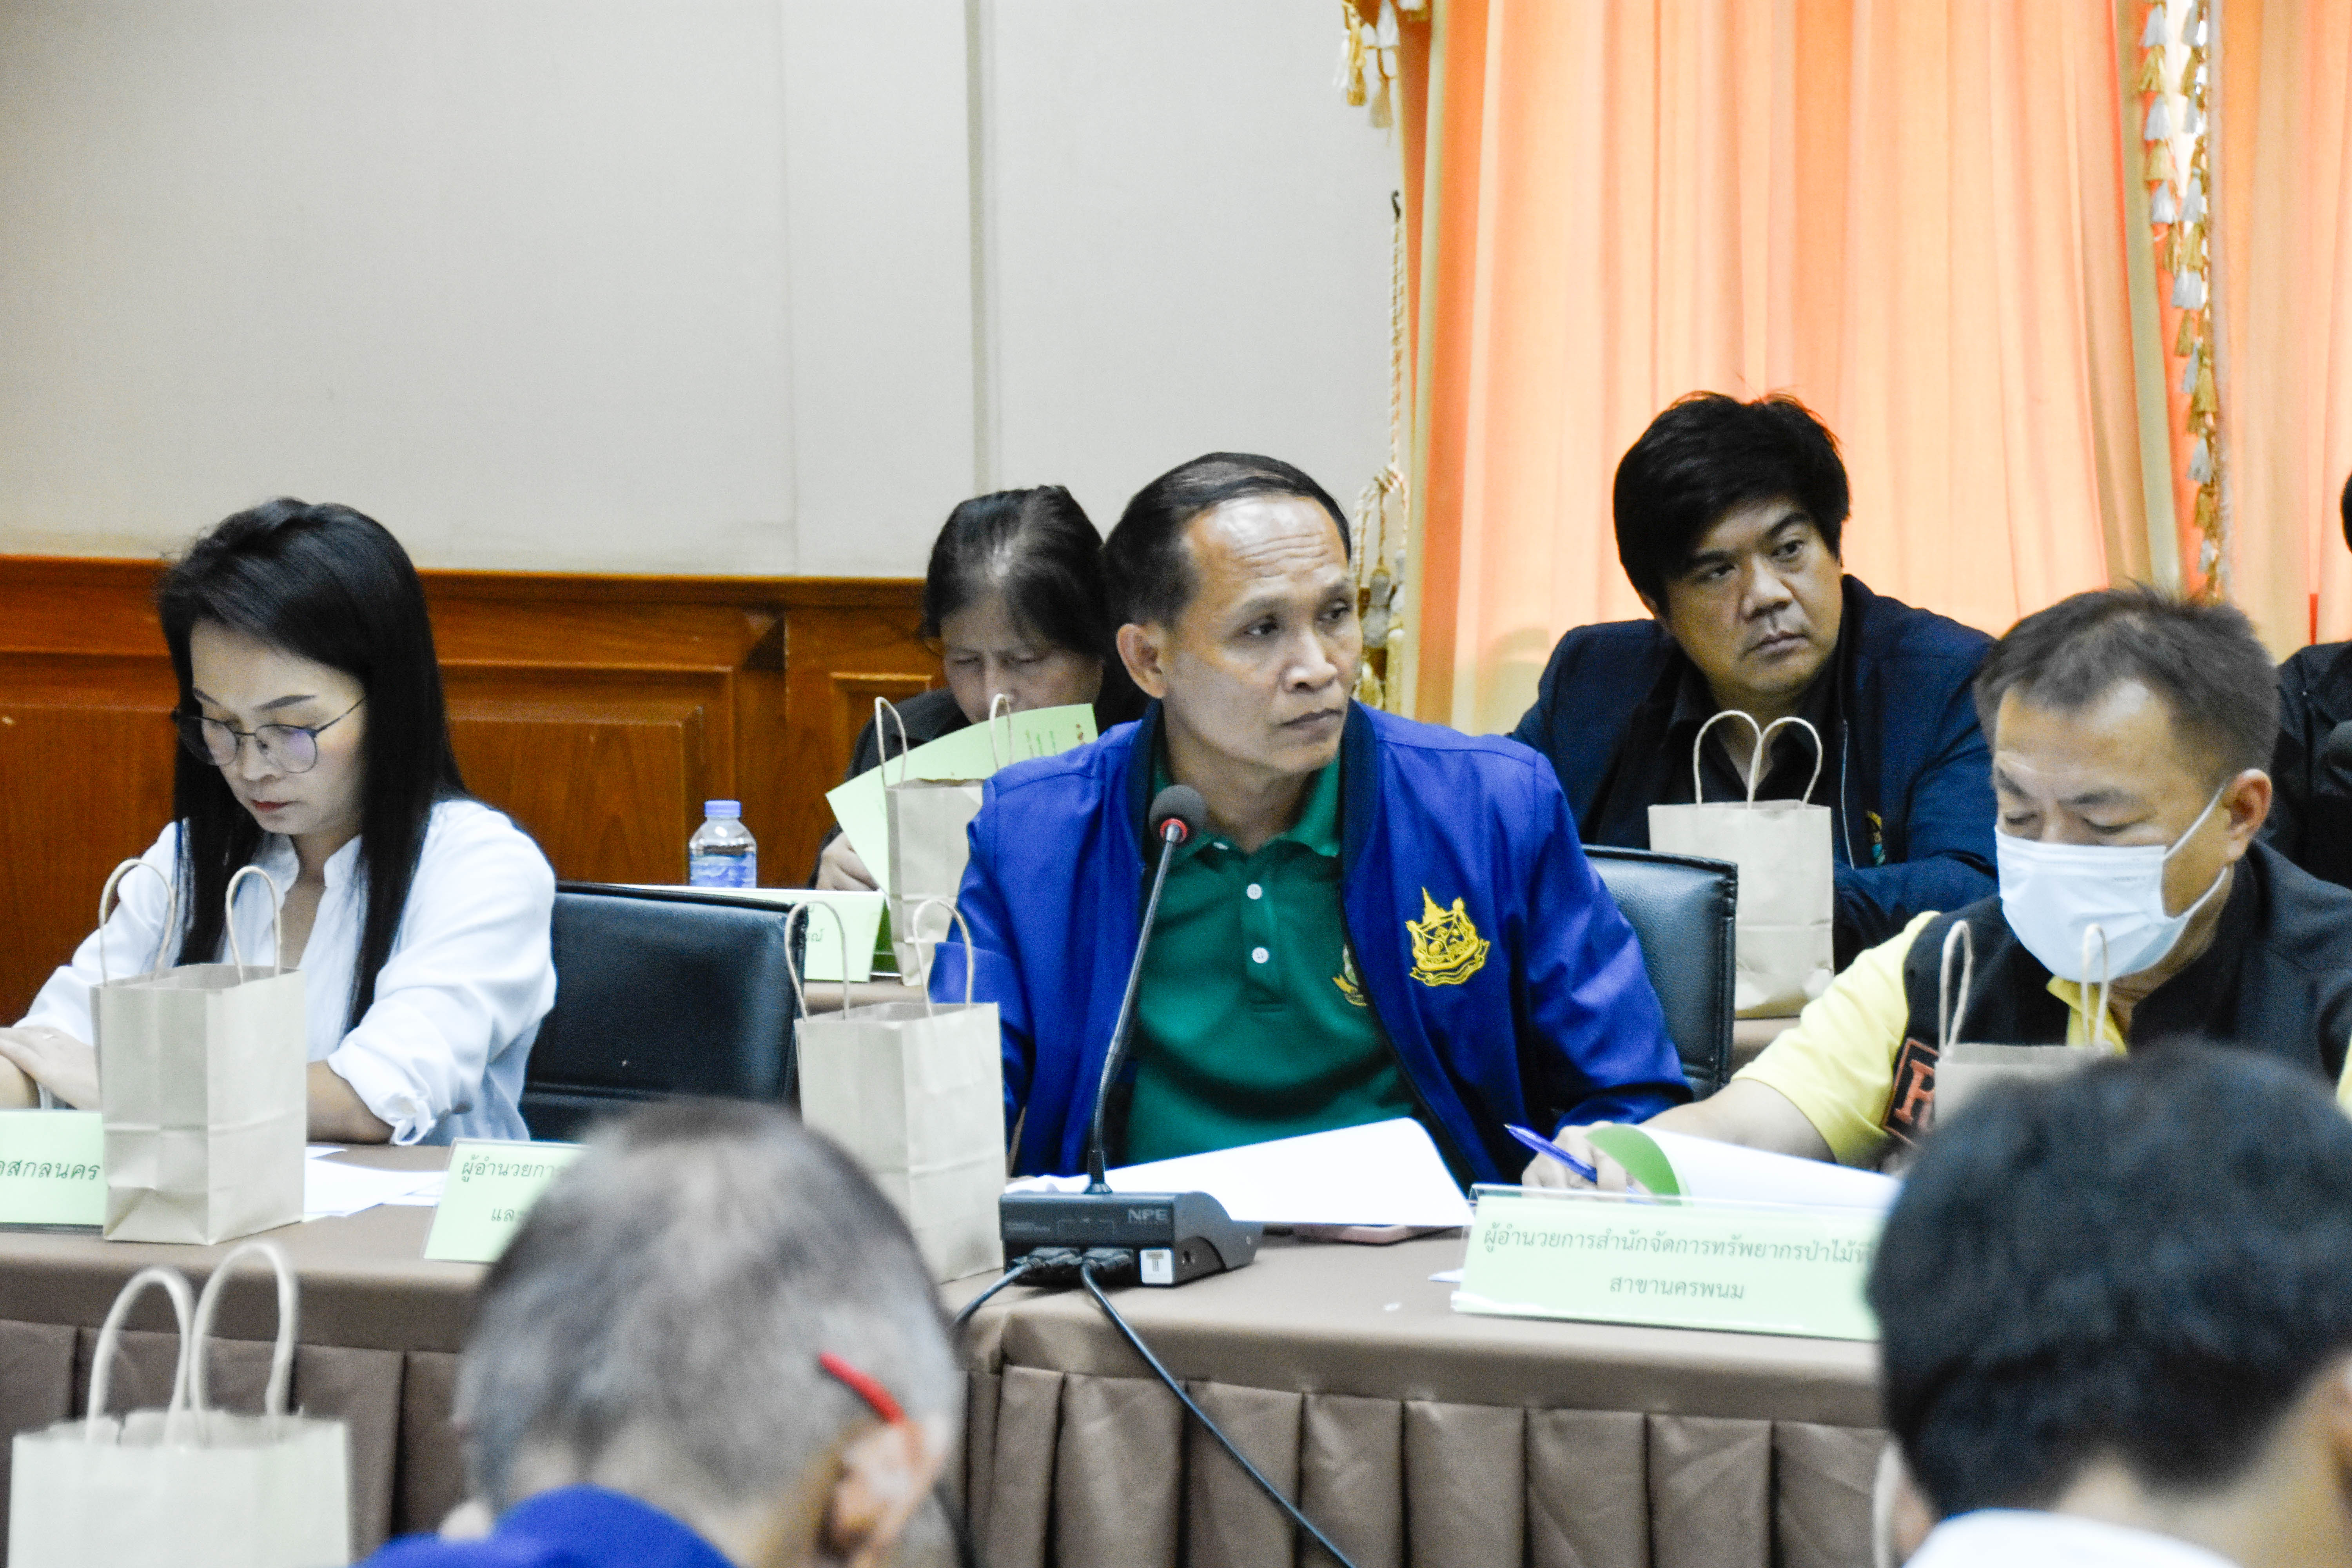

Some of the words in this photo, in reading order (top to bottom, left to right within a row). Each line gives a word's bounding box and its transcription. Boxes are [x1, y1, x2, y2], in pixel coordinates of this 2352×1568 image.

[462, 1154, 564, 1182] ผู้อำนวยกา
[491, 1209, 521, 1221] แล
[1128, 1209, 1167, 1222] NPE
[1610, 1276, 1744, 1299] สาขานครพนม
